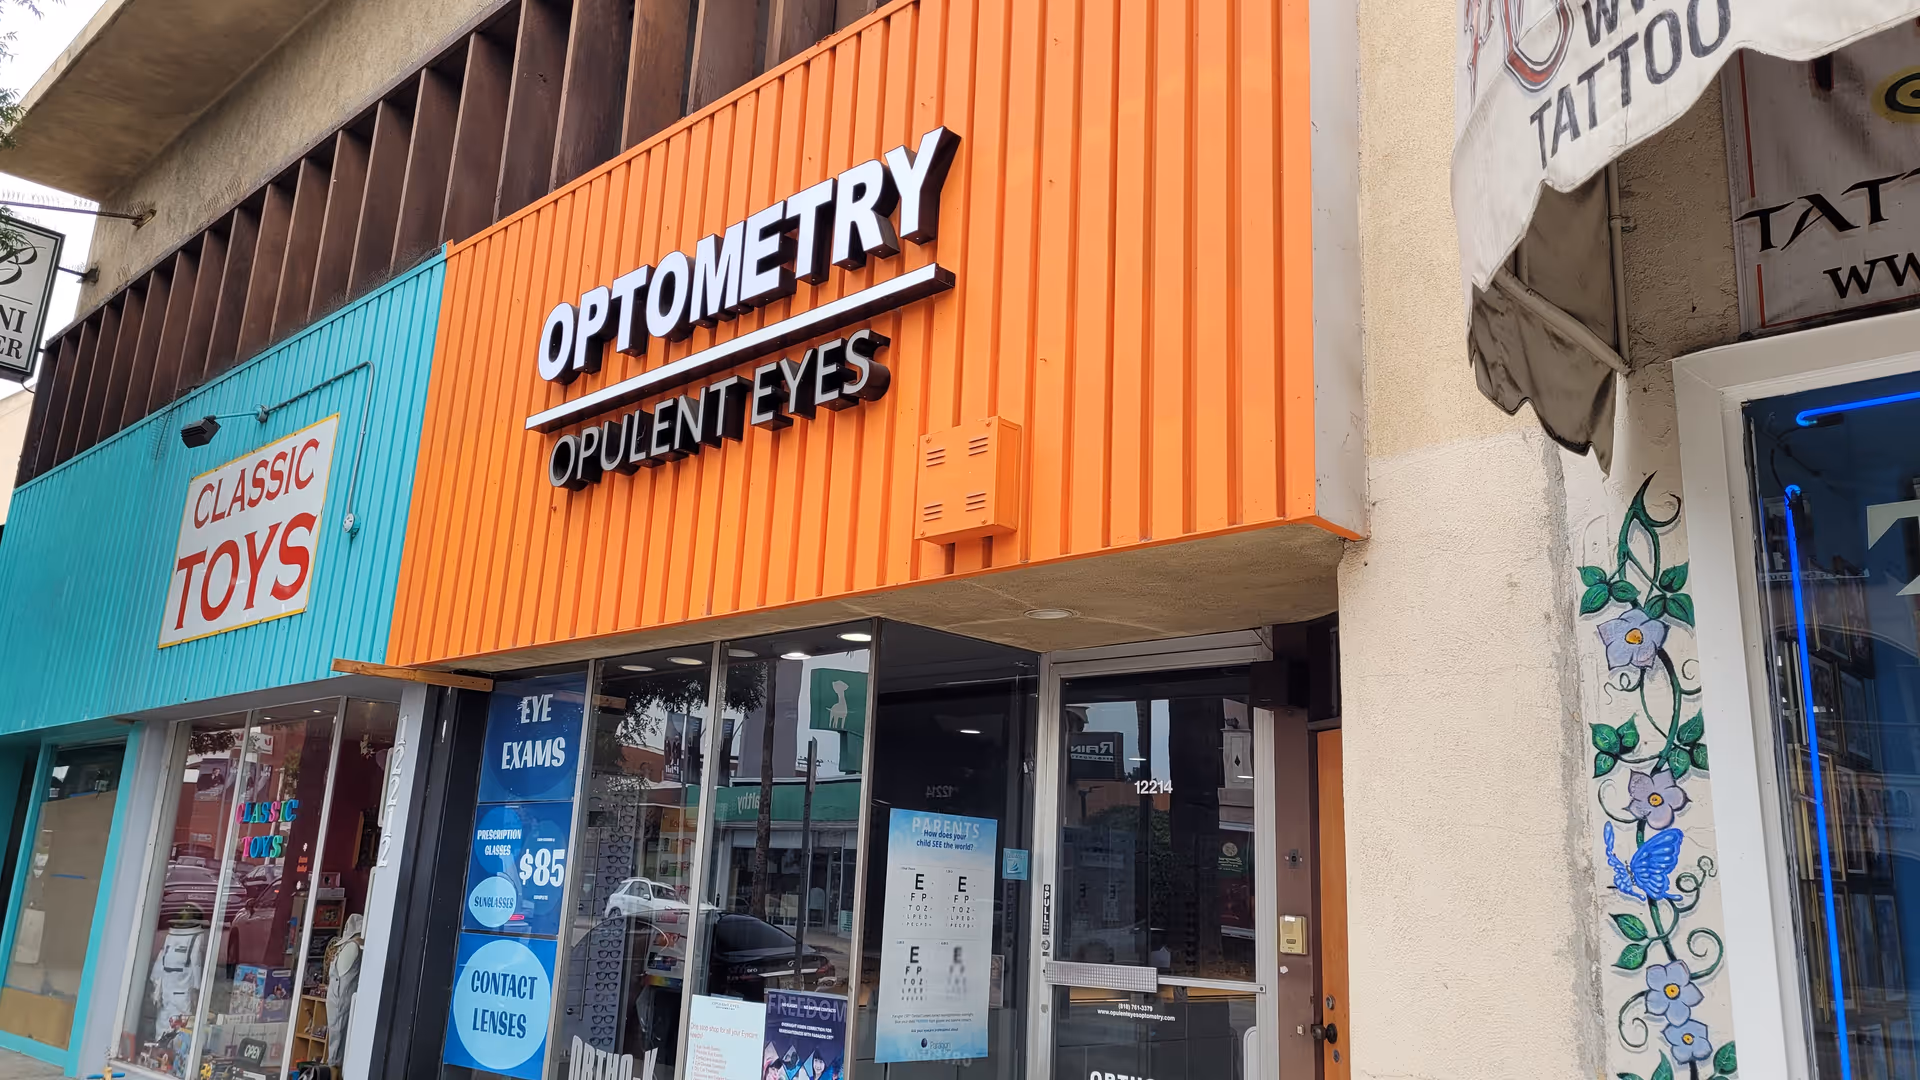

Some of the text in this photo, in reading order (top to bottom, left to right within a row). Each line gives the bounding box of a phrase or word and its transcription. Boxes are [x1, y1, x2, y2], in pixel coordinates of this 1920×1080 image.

[1530, 0, 1731, 169] TATTOO
[1734, 168, 1920, 252] TAT
[538, 126, 959, 384] OPTOMETRY
[549, 330, 886, 489] OPULENT EYES
[193, 438, 320, 529] CLASSIC
[174, 512, 318, 631] TOYS
[520, 694, 553, 725] EYE
[501, 737, 566, 770] EXAMS
[1134, 780, 1173, 795] 12214
[235, 799, 299, 824] CLASSIC
[477, 829, 522, 841] PRESCRIPTION
[912, 816, 980, 838] PARENTS
[923, 829, 967, 841] How does your
[241, 834, 283, 858] TOYS
[484, 844, 511, 856] GLASSES
[916, 839, 974, 851] child SEE the world?
[519, 848, 565, 888] $85
[915, 873, 925, 891] E
[958, 875, 967, 893] E
[474, 895, 514, 910] SUNGLASSES
[471, 969, 538, 1000] CONTACT
[768, 993, 847, 1022] FREEDOM
[472, 1008, 528, 1039] LENSES
[244, 1044, 261, 1060] OPEN
